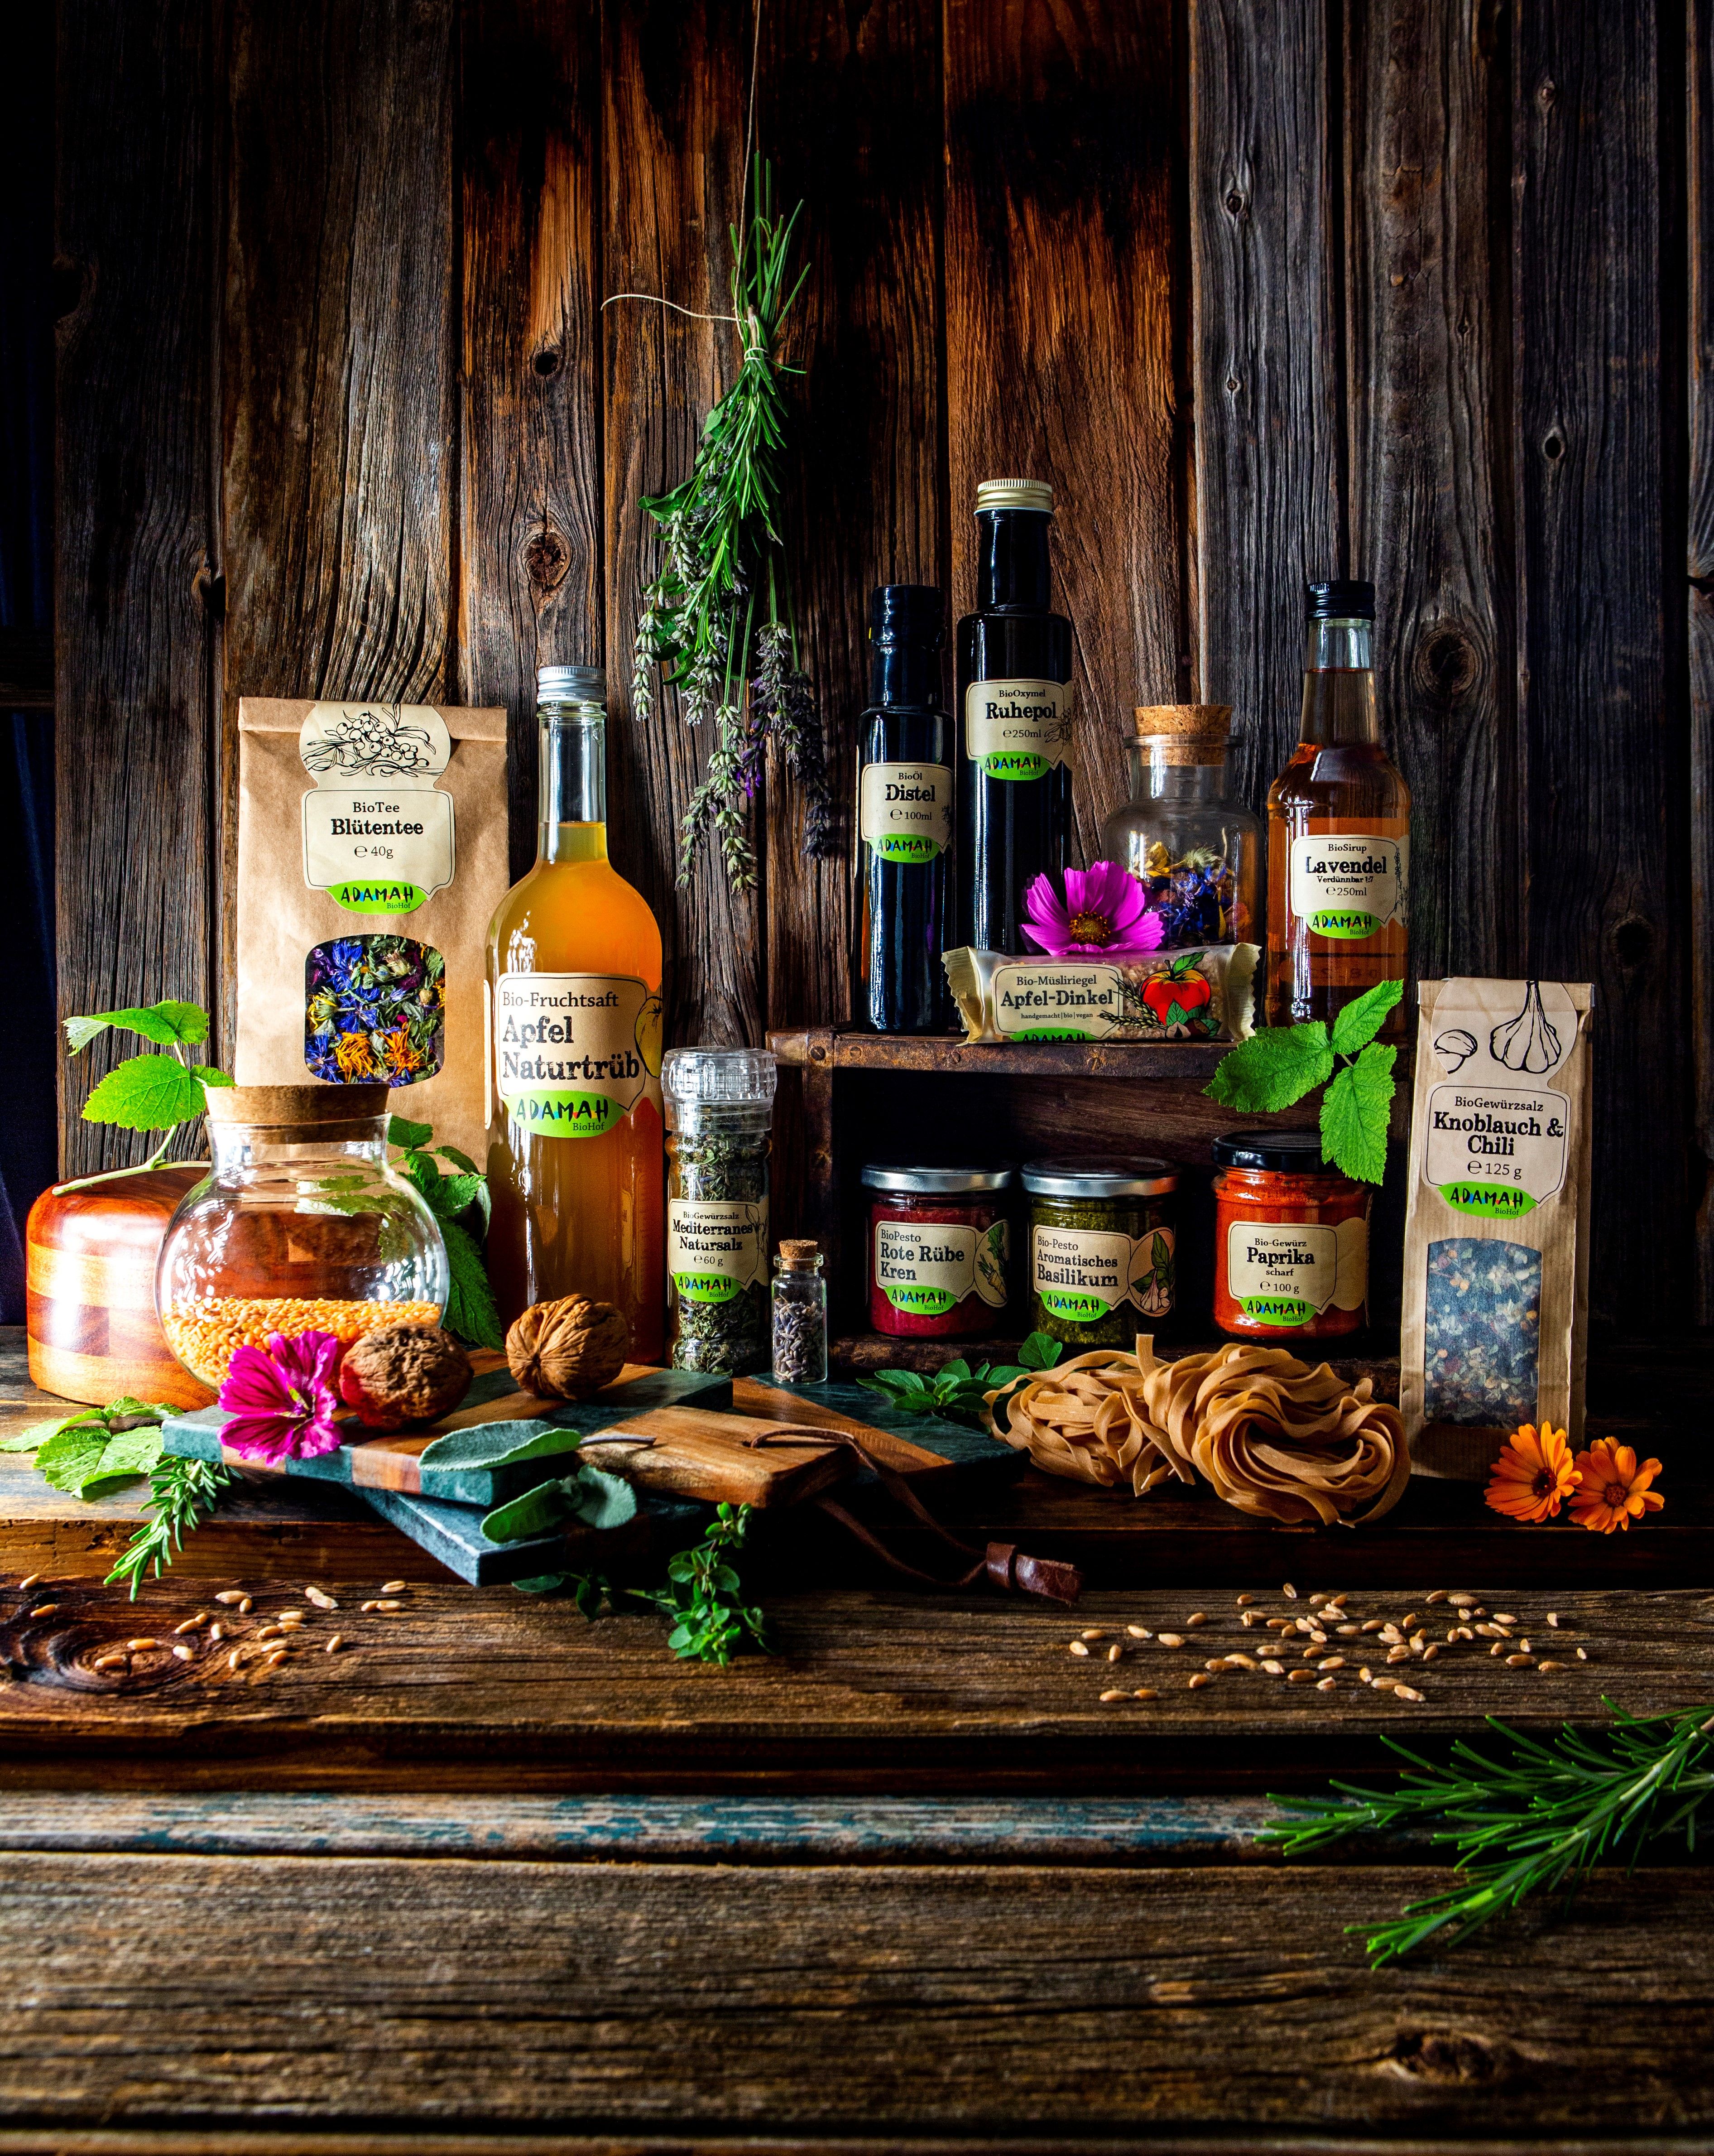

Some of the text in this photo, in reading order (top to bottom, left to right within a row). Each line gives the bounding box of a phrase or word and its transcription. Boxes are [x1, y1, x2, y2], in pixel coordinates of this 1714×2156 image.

[999, 689, 1045, 698] BioOxymel
[985, 702, 1057, 722] Ruhepol
[984, 756, 1040, 770] ADAMAH
[898, 771, 922, 780] BioÖl
[885, 784, 935, 801] Distel
[352, 802, 399, 812] BioTee
[331, 819, 423, 835] Blütentee
[371, 847, 393, 859] 40g
[877, 839, 931, 852] ADAMAH
[1328, 844, 1366, 853] BioSirup
[1305, 857, 1386, 873] Lavendel
[341, 886, 413, 903] ADAMAH
[1312, 914, 1371, 929] ADAMAH
[1017, 975, 1096, 987] Bio-Müsliriegel
[503, 991, 618, 1006] Bio-Fruchtsaft
[1001, 989, 1113, 1009] Apfel-Dinkel
[503, 1015, 574, 1048] Apfel
[503, 1050, 639, 1079] Naturtrüb
[517, 1098, 608, 1123] ADAMAH
[1455, 1096, 1543, 1111] BioGewürzsalz
[1433, 1111, 1563, 1137] Knoblauch &
[1468, 1135, 1514, 1155] Chili
[1485, 1163, 1509, 1174] 125
[1514, 1167, 1521, 1179] g
[1450, 1187, 1522, 1209] ADAMAH
[673, 1219, 753, 1234] Mediterranes
[679, 1236, 742, 1250] Natursalz
[881, 1229, 921, 1242] BioPesto
[1037, 1236, 1078, 1250] Bio-Pesto
[1255, 1238, 1306, 1246] Bio-Gewürz
[880, 1242, 964, 1261] Rote Rübe
[1037, 1249, 1118, 1267] Aromatisches
[1247, 1246, 1315, 1267] Paprika
[880, 1261, 917, 1280] Kren
[1037, 1264, 1118, 1286] Basilikum
[678, 1275, 730, 1292] ADAMAH
[891, 1289, 946, 1305] ADAMAH
[1047, 1294, 1099, 1312] ADAMAH
[1247, 1300, 1305, 1316] ADAMAH
